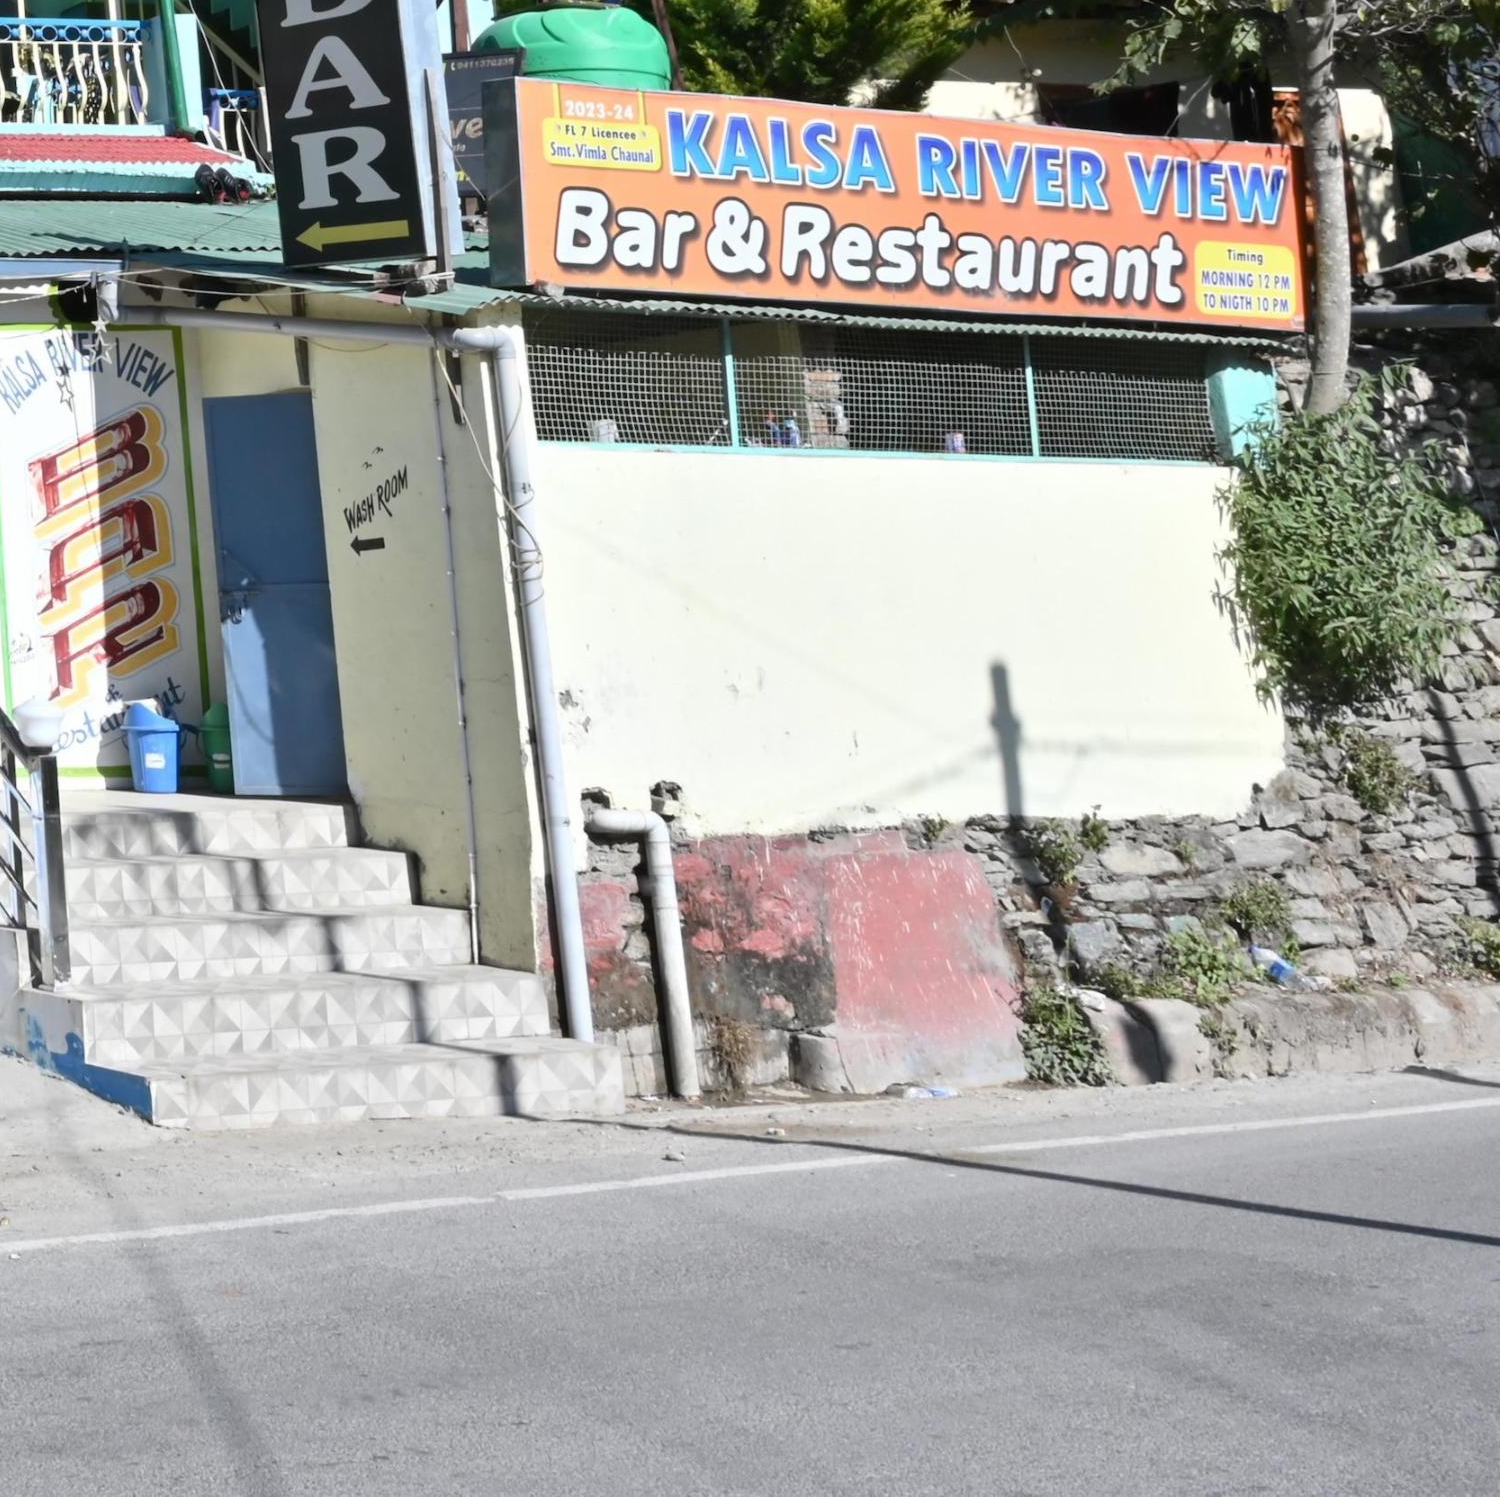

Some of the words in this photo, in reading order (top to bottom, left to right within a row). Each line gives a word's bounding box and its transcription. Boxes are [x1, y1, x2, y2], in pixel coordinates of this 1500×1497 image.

[564, 99, 634, 121] 2023-24
[565, 124, 576, 136] FL
[581, 126, 587, 137] 7
[591, 127, 637, 141] Licencee
[610, 145, 654, 164] Chaunal
[664, 106, 897, 194] KALSA
[915, 132, 1110, 213] RIVER
[1124, 150, 1289, 226] VIEW
[553, 185, 697, 271] Bar
[704, 195, 768, 275] &
[779, 201, 1187, 306] Restaurant
[1227, 248, 1264, 266] Timing
[1201, 270, 1254, 288] MORNING
[1258, 274, 1270, 289] 12
[1274, 275, 1291, 290] PM
[1203, 293, 1216, 309] TO
[1220, 294, 1252, 311] NIGTH
[1257, 297, 1269, 312] 10
[1273, 298, 1289, 313] PM
[115, 336, 175, 398] VIEW
[343, 492, 375, 534] WASH
[376, 463, 408, 517] ROOM
